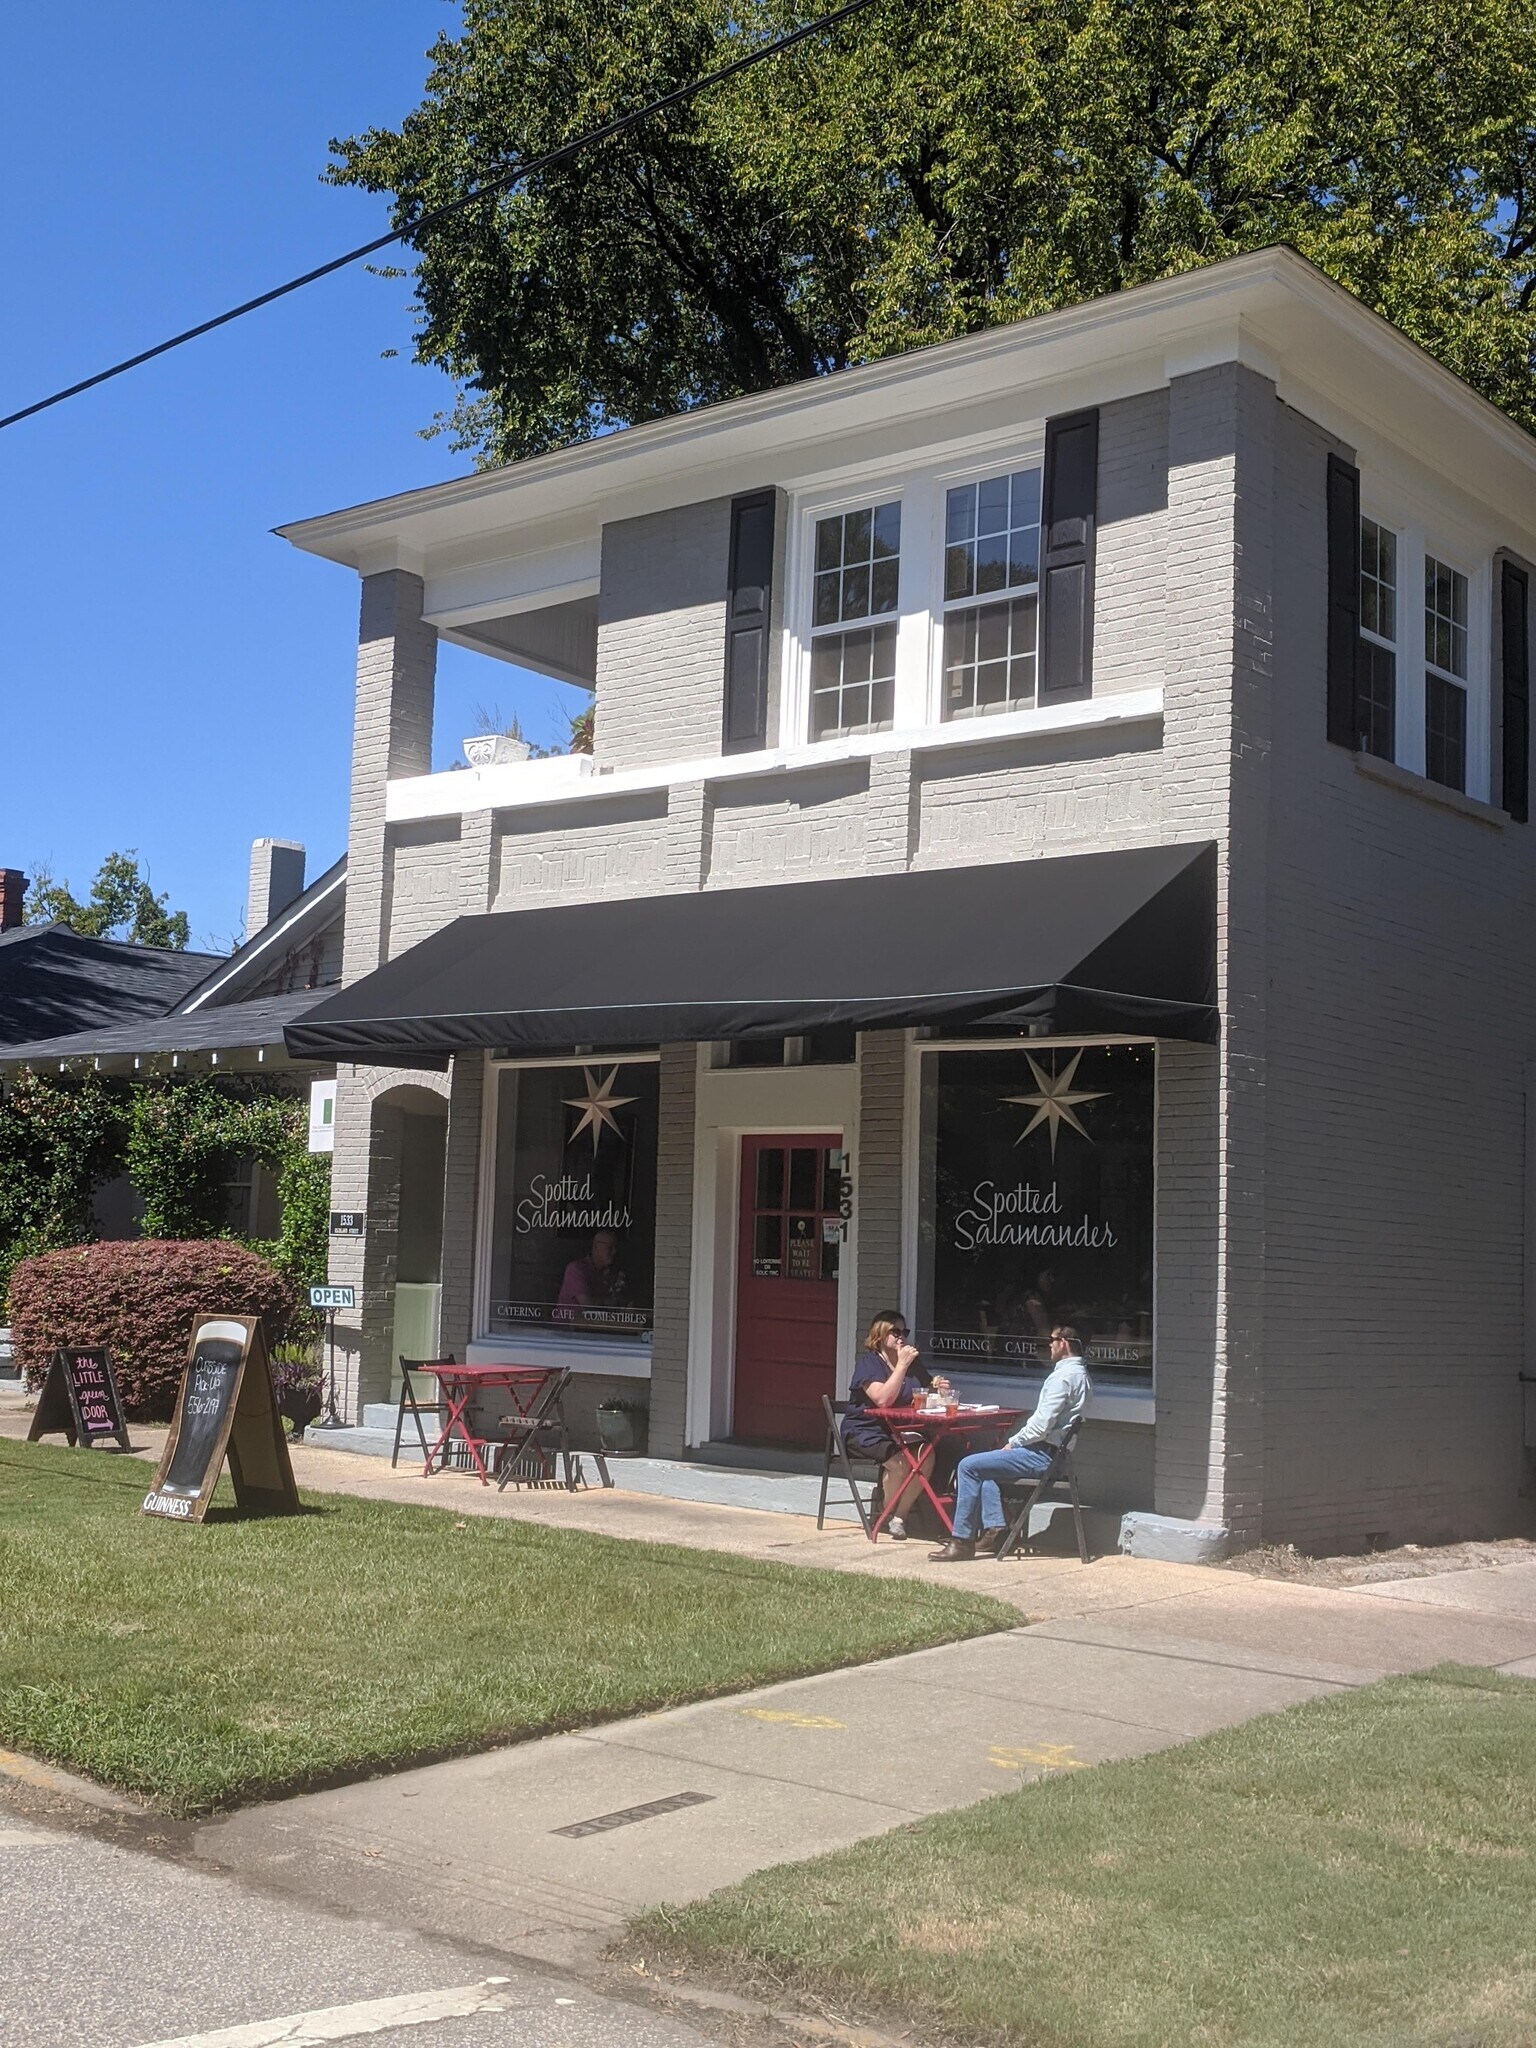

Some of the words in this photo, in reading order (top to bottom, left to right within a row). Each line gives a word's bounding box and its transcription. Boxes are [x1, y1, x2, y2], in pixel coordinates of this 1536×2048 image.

[530, 1172, 594, 1209] Spotted
[839, 1153, 853, 1243] 1531
[973, 1180, 1063, 1222] Spotted
[340, 1214, 354, 1226] 1533
[516, 1199, 633, 1234] Salamander
[954, 1209, 1118, 1250] Salamander
[313, 1289, 352, 1304] OPEN
[497, 1305, 541, 1318] CATERING
[551, 1308, 575, 1320] CAFE
[583, 1311, 647, 1324] COMESTIBLES
[929, 1336, 990, 1351] CATERING
[1005, 1341, 1038, 1354] CAFE
[1085, 1346, 1139, 1361] STIBLES
[76, 1356, 98, 1369] the
[72, 1371, 105, 1385] LITTLE
[79, 1389, 110, 1405] green
[81, 1404, 108, 1420] DOOR
[143, 1491, 192, 1516] GUINNESS
